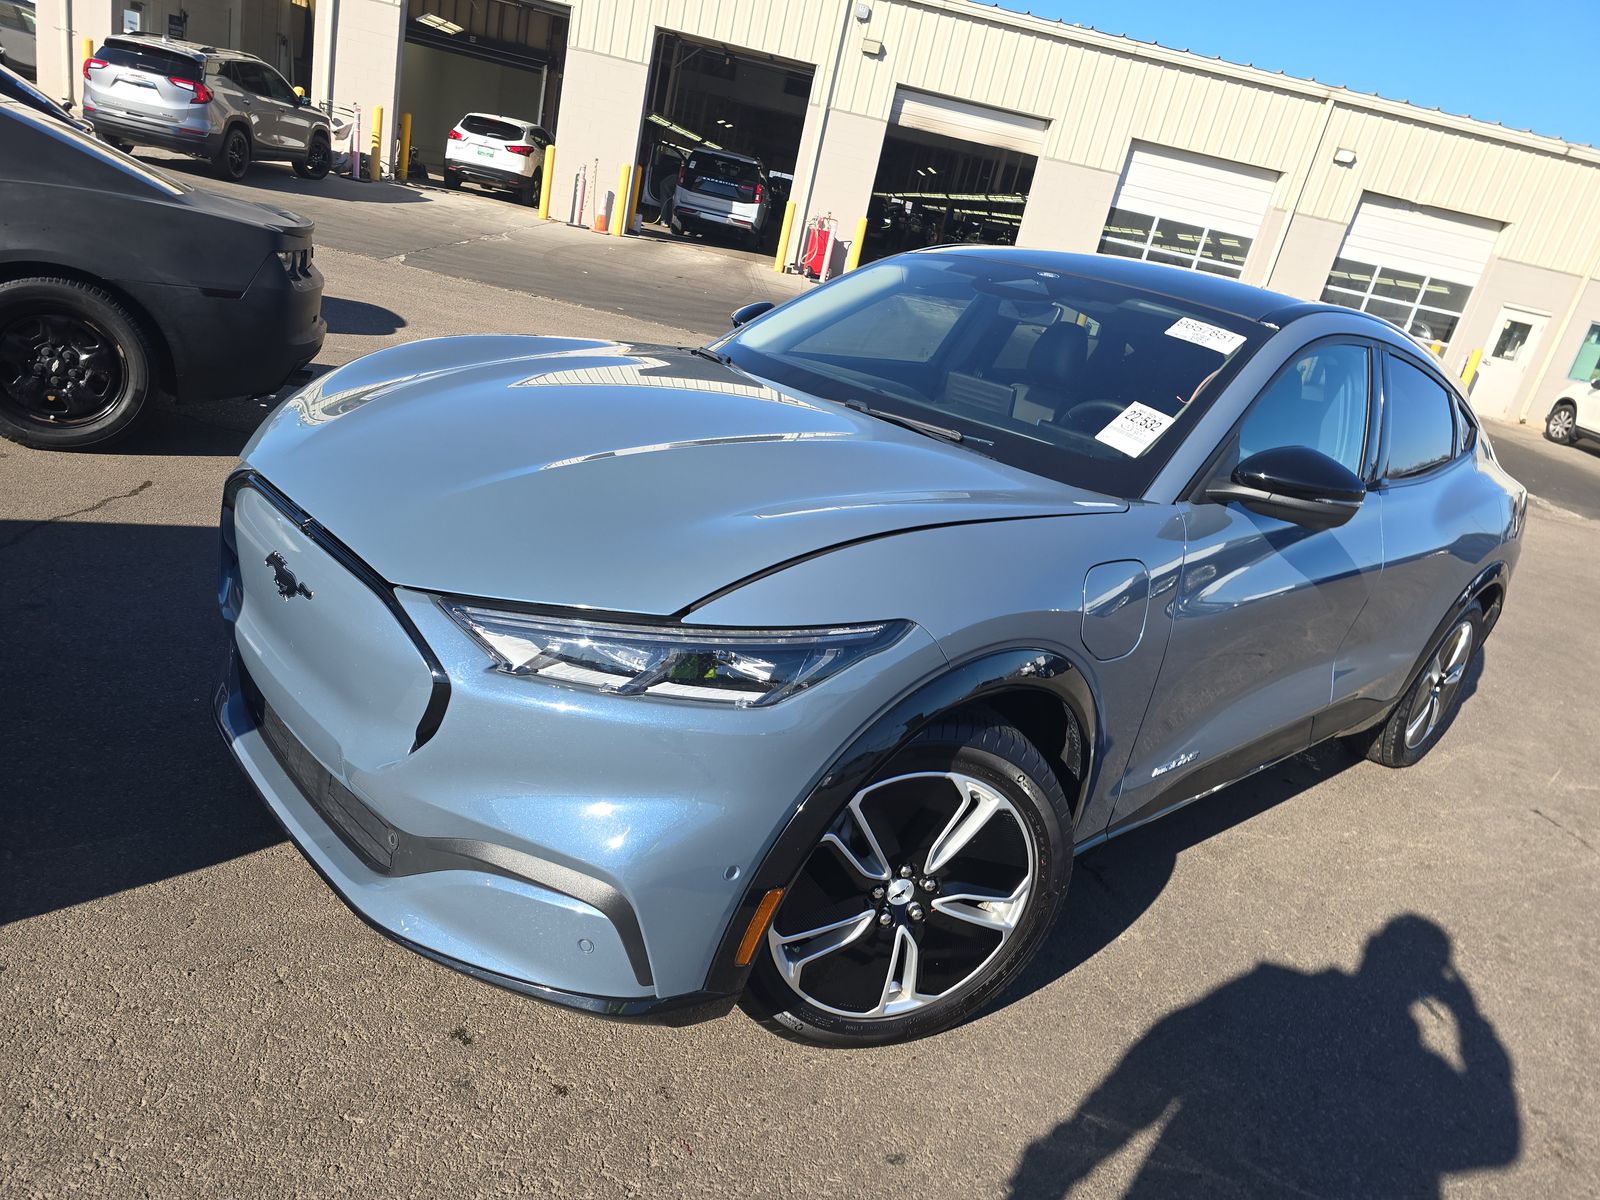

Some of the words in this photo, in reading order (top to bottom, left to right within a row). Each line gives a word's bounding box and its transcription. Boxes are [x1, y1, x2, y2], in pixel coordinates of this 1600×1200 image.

[703, 177, 739, 187] EXPEDITION
[1177, 319, 1236, 343] 9657851
[1124, 410, 1163, 432] 22:532
